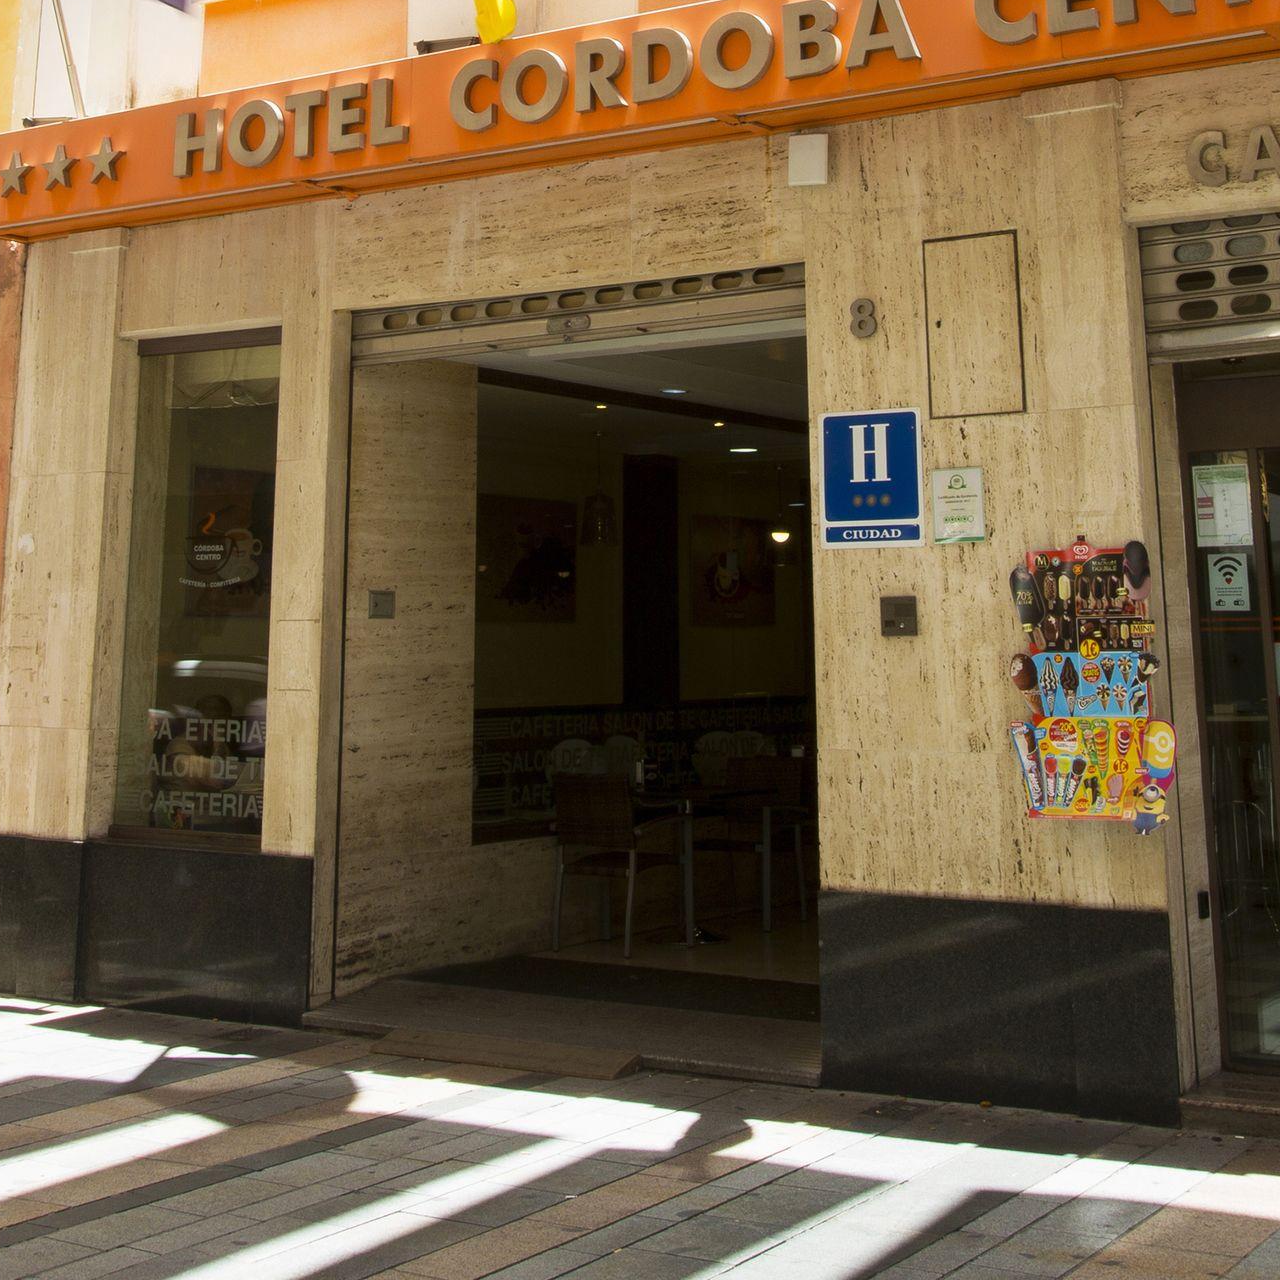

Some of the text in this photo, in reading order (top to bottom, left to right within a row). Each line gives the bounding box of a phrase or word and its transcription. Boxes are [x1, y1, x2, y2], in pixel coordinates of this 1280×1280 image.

[173, 78, 409, 178] HOTEL
[849, 298, 877, 338] 8
[849, 423, 891, 482] H
[842, 528, 902, 540] CIUDAD
